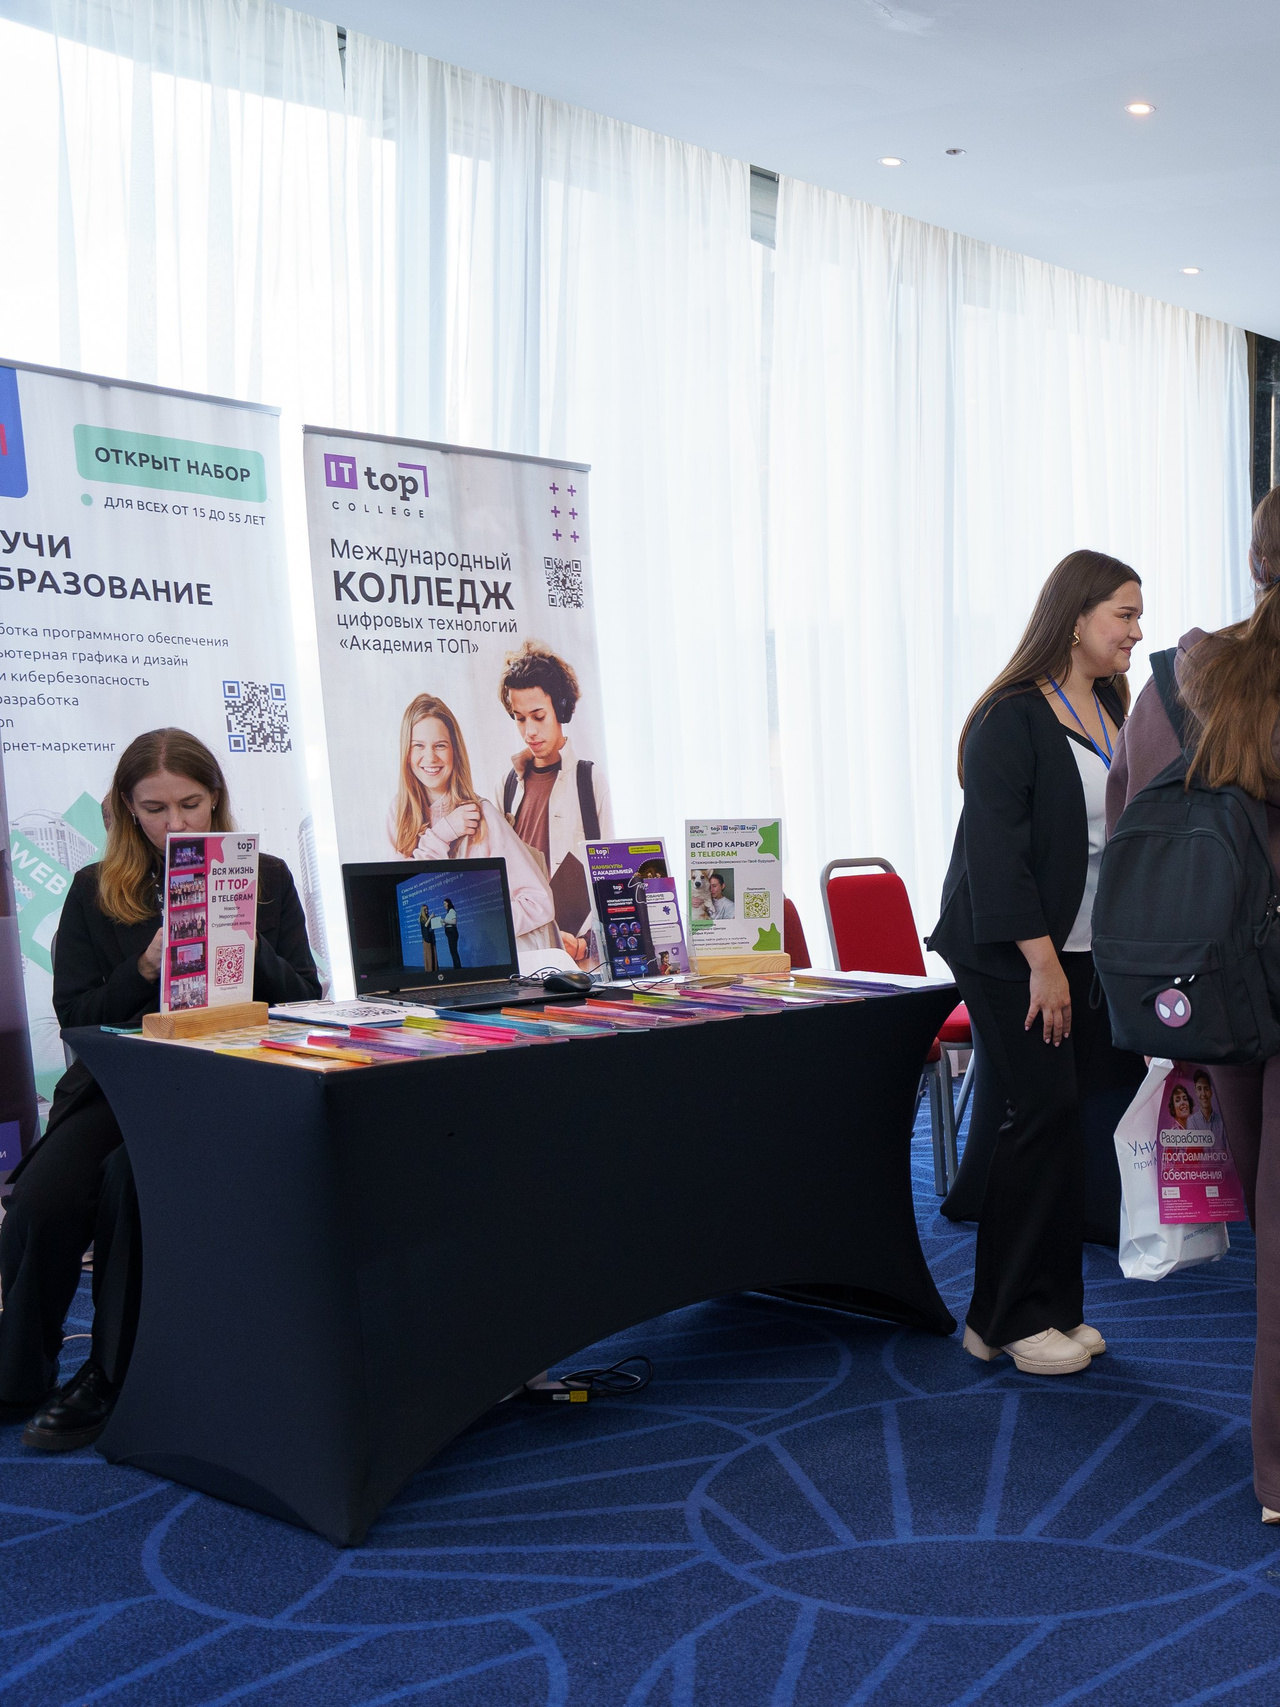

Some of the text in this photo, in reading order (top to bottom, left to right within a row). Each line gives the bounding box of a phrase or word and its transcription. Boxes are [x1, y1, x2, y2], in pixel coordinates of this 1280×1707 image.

[95, 447, 251, 482] ОТКРЫТ НАБОР
[328, 460, 419, 501] IT top
[104, 497, 266, 526] ДЛЯ ВСЕХ ОТ 15 ДО 55 ЛЕТ
[332, 501, 425, 519] COLLEGE
[0, 529, 71, 559] УЧИ
[330, 538, 512, 572] Международный
[0, 566, 213, 606] БРАЗОВАНИЕ
[333, 570, 515, 615] КОЛЛЕДЖ
[337, 611, 518, 633] цифровых технологий
[43, 627, 144, 643] программного
[147, 632, 229, 647] обеспечения
[339, 635, 480, 654] «Академия ТОП»
[72, 650, 128, 664] графика
[131, 656, 140, 664] и
[143, 655, 189, 666] дизайн
[11, 670, 150, 687] кибербезопасность
[3, 741, 116, 753] рнет-маркетинг
[237, 842, 253, 852] top
[691, 841, 706, 849] ВСЁ
[10, 841, 69, 896] WEB
[212, 867, 254, 876] ВСЯ ЖИЗНЬ
[215, 879, 248, 891] IT TOP
[218, 893, 253, 902] TELEGRAM
[1161, 1131, 1213, 1145] Разработка
[1162, 1152, 1228, 1164] программного
[1163, 1168, 1222, 1181] обеспечения
